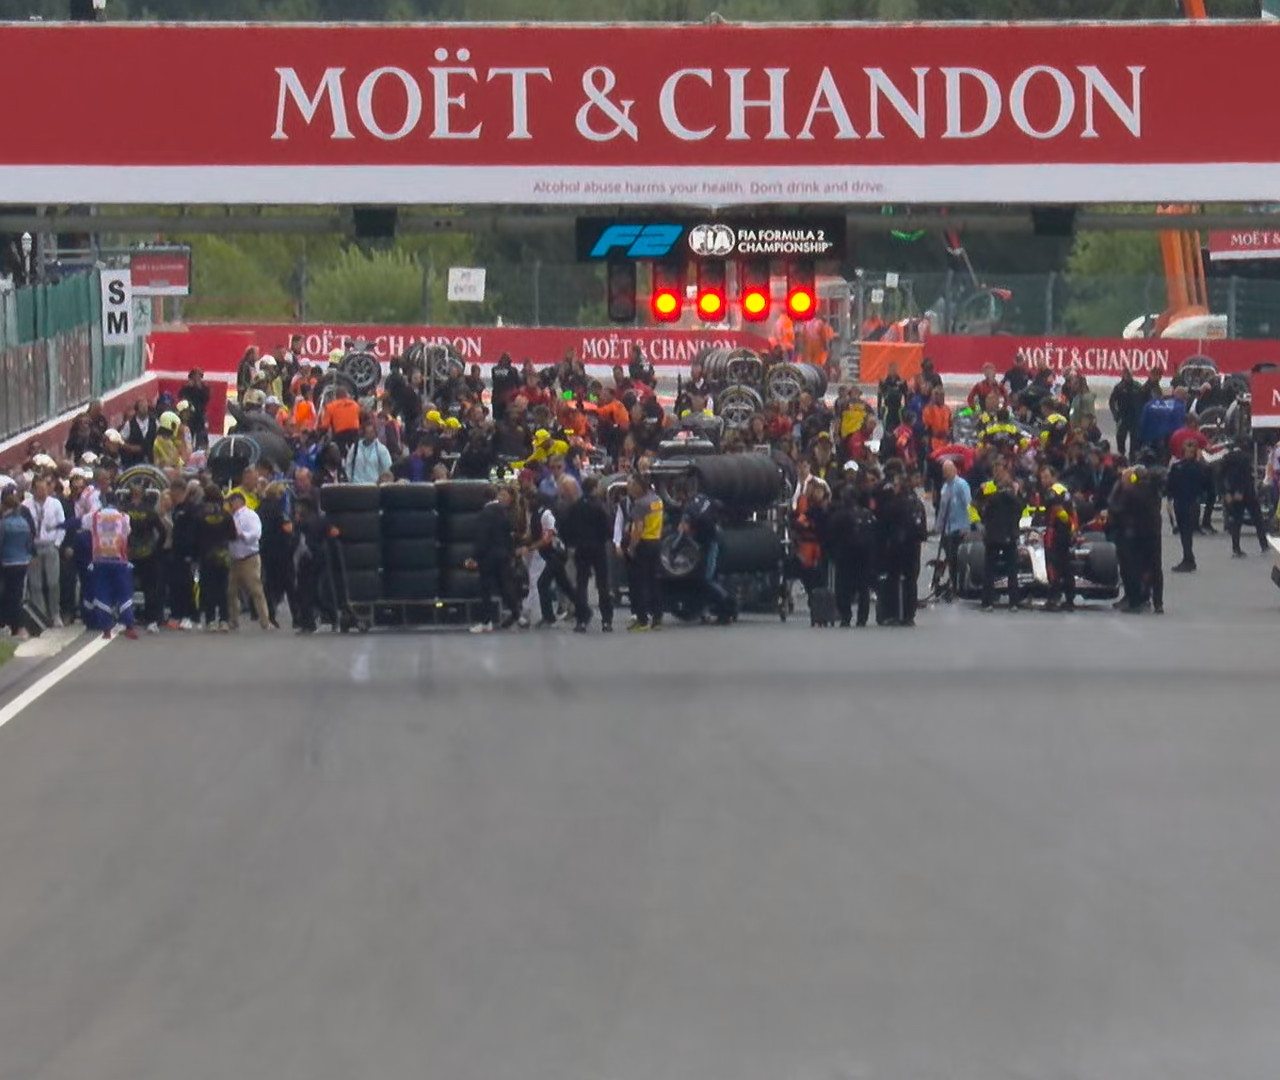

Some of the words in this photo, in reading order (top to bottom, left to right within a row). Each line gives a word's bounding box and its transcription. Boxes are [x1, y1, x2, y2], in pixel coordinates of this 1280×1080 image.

[271, 47, 552, 140] MOËT
[575, 66, 638, 141] &
[659, 65, 1146, 139] CHANDON
[533, 182, 580, 193] Alcohol
[584, 182, 620, 193] abuse
[626, 182, 665, 193] harms
[670, 183, 697, 195] your
[787, 181, 819, 193] drink
[824, 181, 848, 193] and
[590, 224, 684, 258] F2
[738, 230, 757, 241] FIA
[759, 230, 816, 241] FORMULA
[818, 230, 825, 240] 2
[1231, 231, 1270, 246] MOËT
[108, 280, 125, 305] S
[107, 312, 128, 334] M
[582, 333, 632, 360] MOËT
[1070, 347, 1083, 370] &
[1085, 348, 1169, 370] CHANDON
